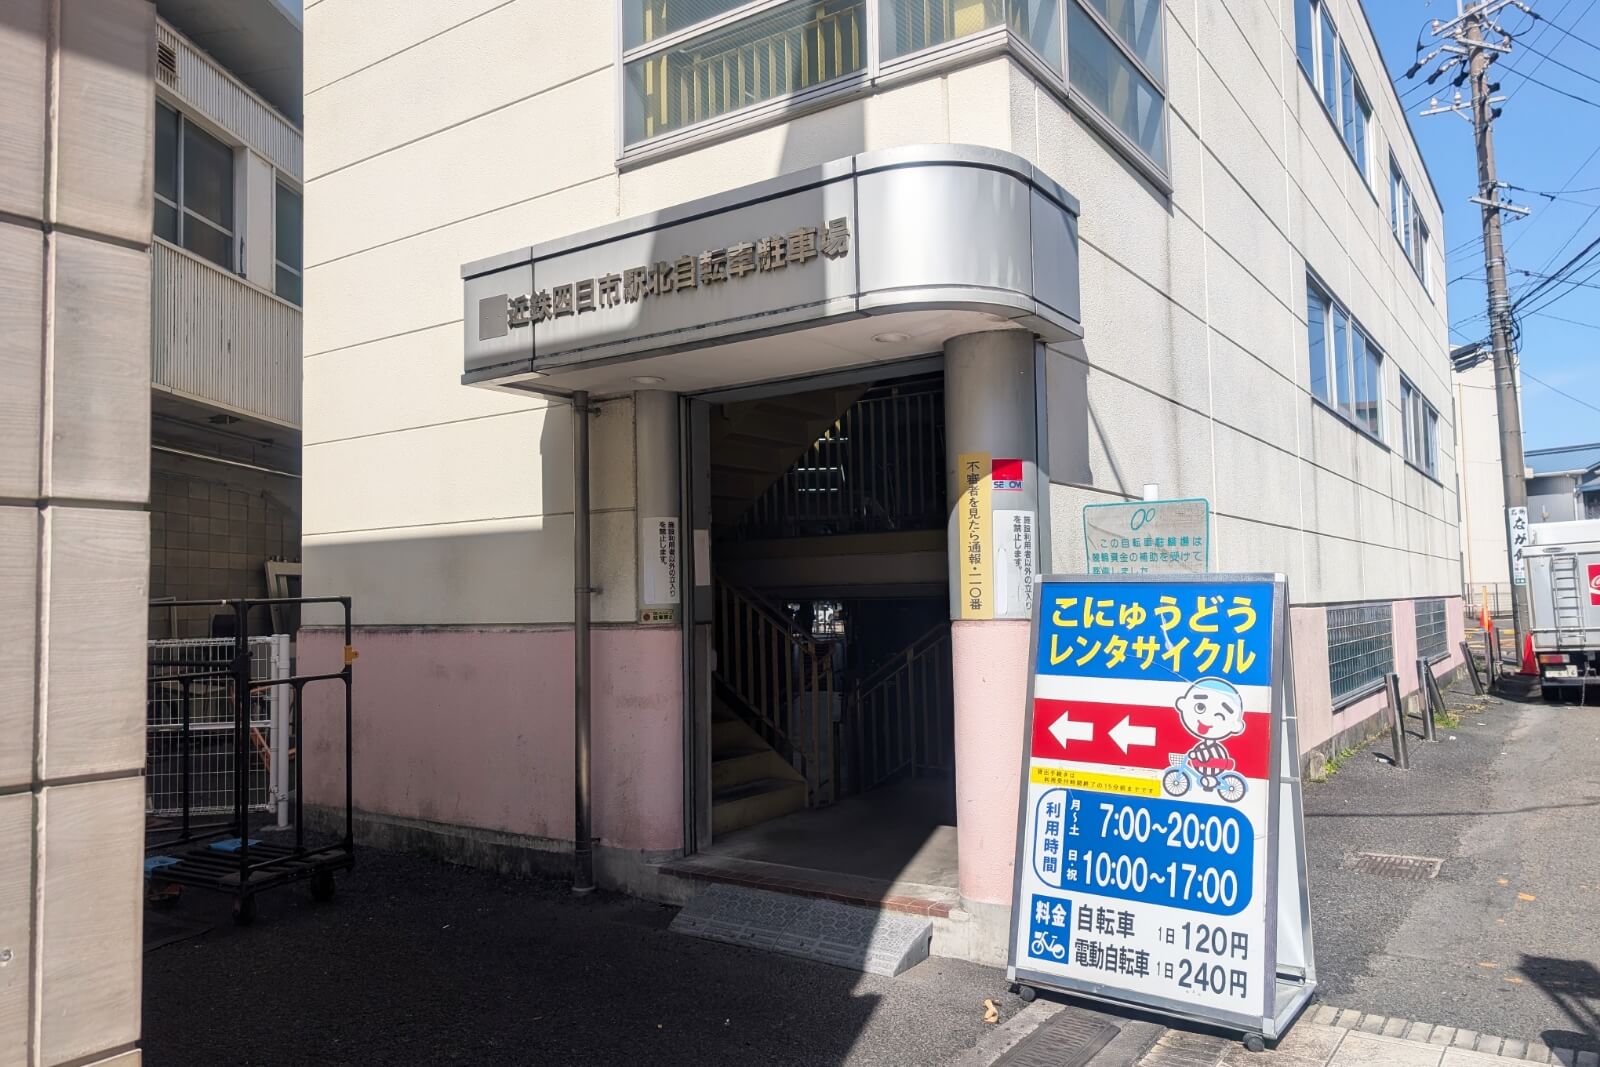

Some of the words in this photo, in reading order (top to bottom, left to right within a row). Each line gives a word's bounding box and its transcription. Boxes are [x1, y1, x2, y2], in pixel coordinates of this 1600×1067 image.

[507, 216, 850, 329] 近鉄四日市駅北自転車駐車場
[993, 481, 1022, 489] SEOM
[1013, 515, 1022, 570] を禁止します。
[1023, 515, 1032, 610] 施設利用者以外の立入り
[1052, 595, 1257, 634] こにゅうどう
[1050, 634, 1257, 675] レンタサイクル
[1042, 801, 1062, 874] 利用時間
[1034, 899, 1067, 929] 料金
[1077, 903, 1136, 939] 自転車
[1157, 926, 1175, 945] 1日
[1181, 921, 1249, 961] 120円
[1074, 936, 1150, 979] 電動自転車
[1156, 961, 1174, 979] 1日
[1178, 958, 1247, 998] 240円
